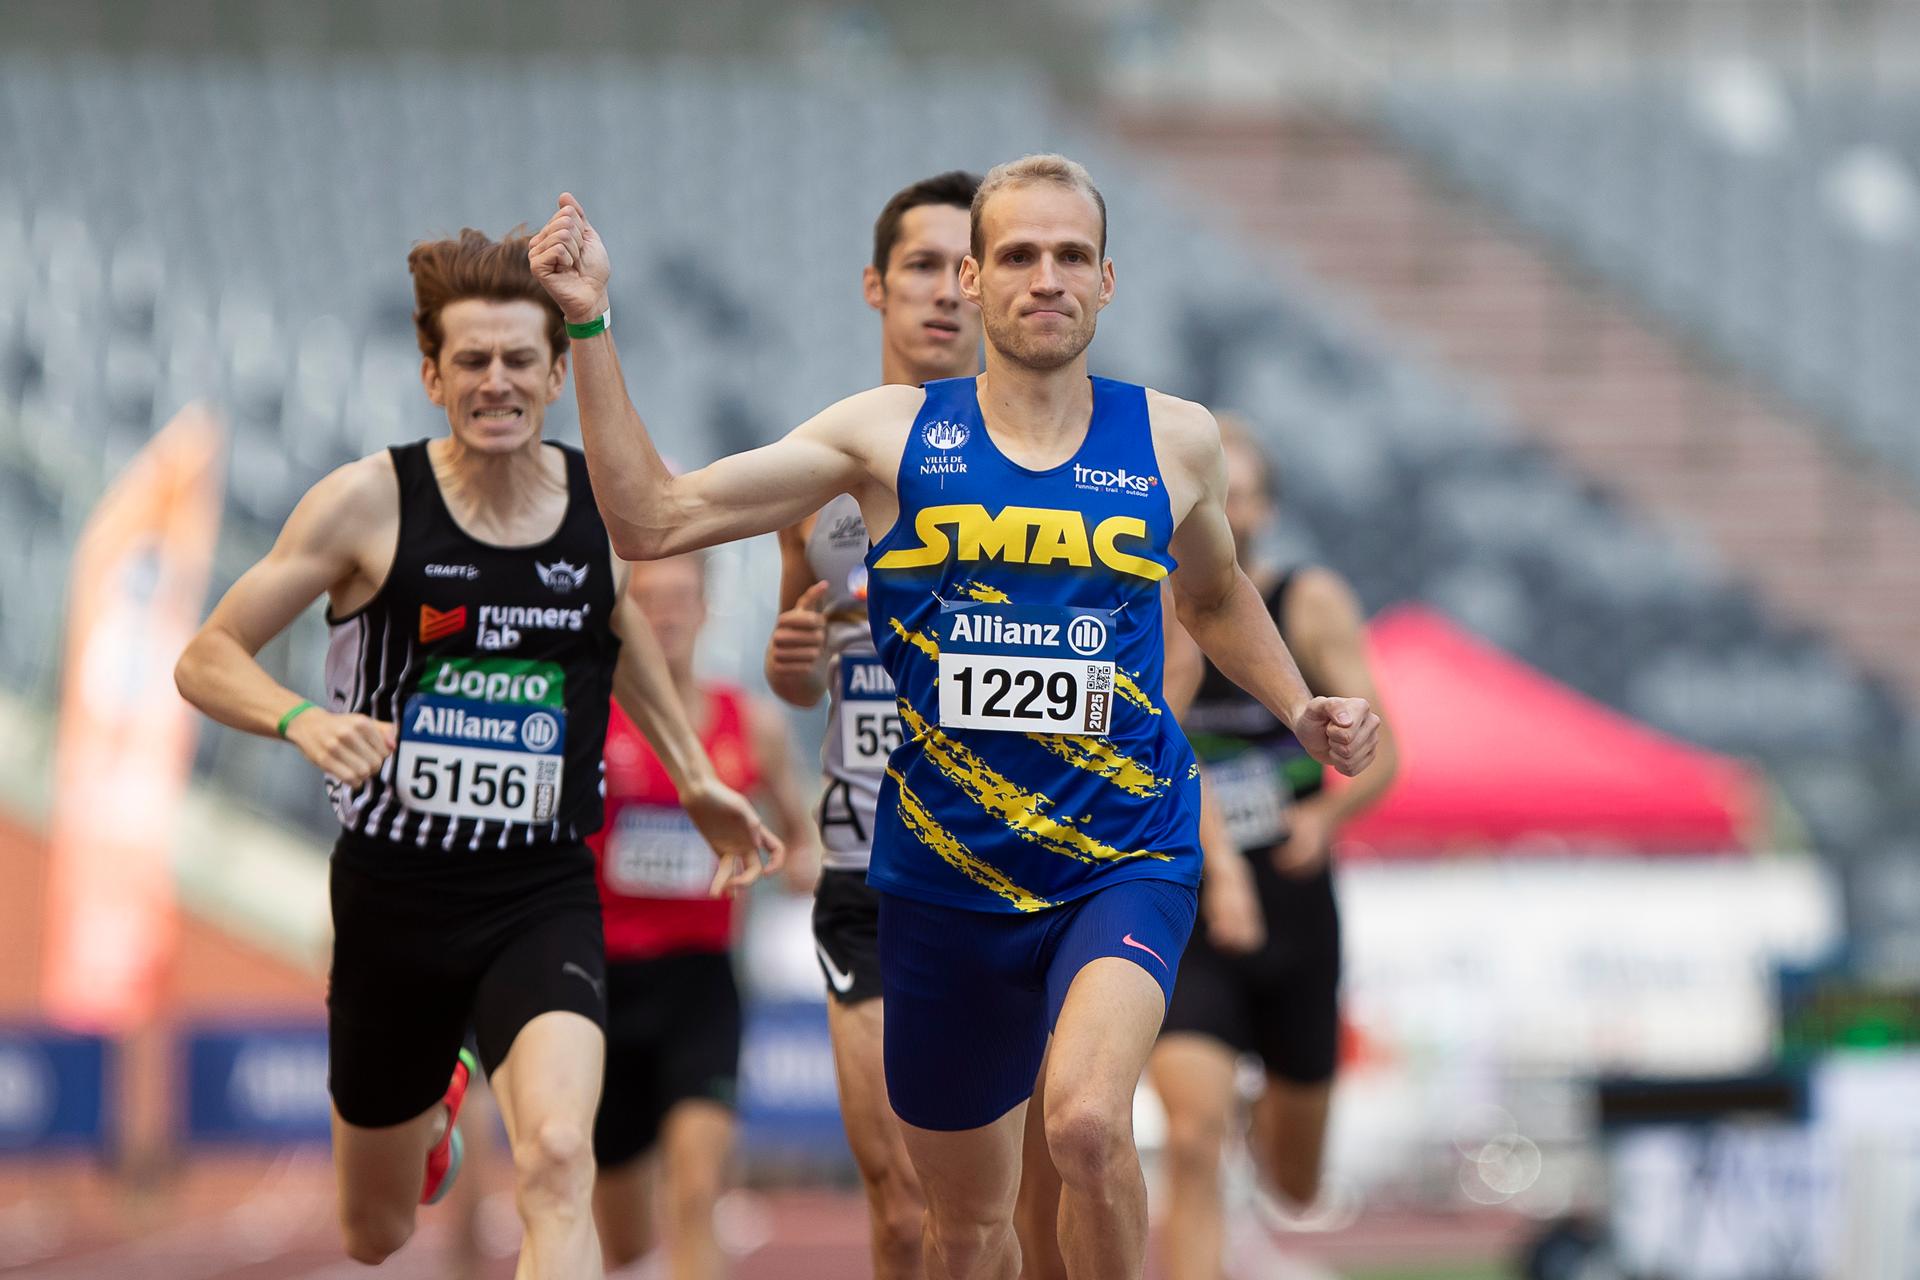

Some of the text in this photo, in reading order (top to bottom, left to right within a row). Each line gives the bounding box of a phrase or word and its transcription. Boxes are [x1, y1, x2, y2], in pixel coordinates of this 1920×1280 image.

[920, 464, 968, 475] NAMUR
[925, 456, 948, 464] VILLE
[1073, 463, 1149, 492] trakks
[1075, 484, 1099, 492] running
[873, 504, 1169, 581] SMAC
[475, 623, 522, 650] lab
[950, 614, 1060, 646] Allianz
[434, 662, 549, 702] bopro
[953, 666, 1078, 721] 1229
[412, 704, 517, 744] Allianz
[1089, 694, 1104, 730] 2025
[410, 755, 527, 809] 5156
